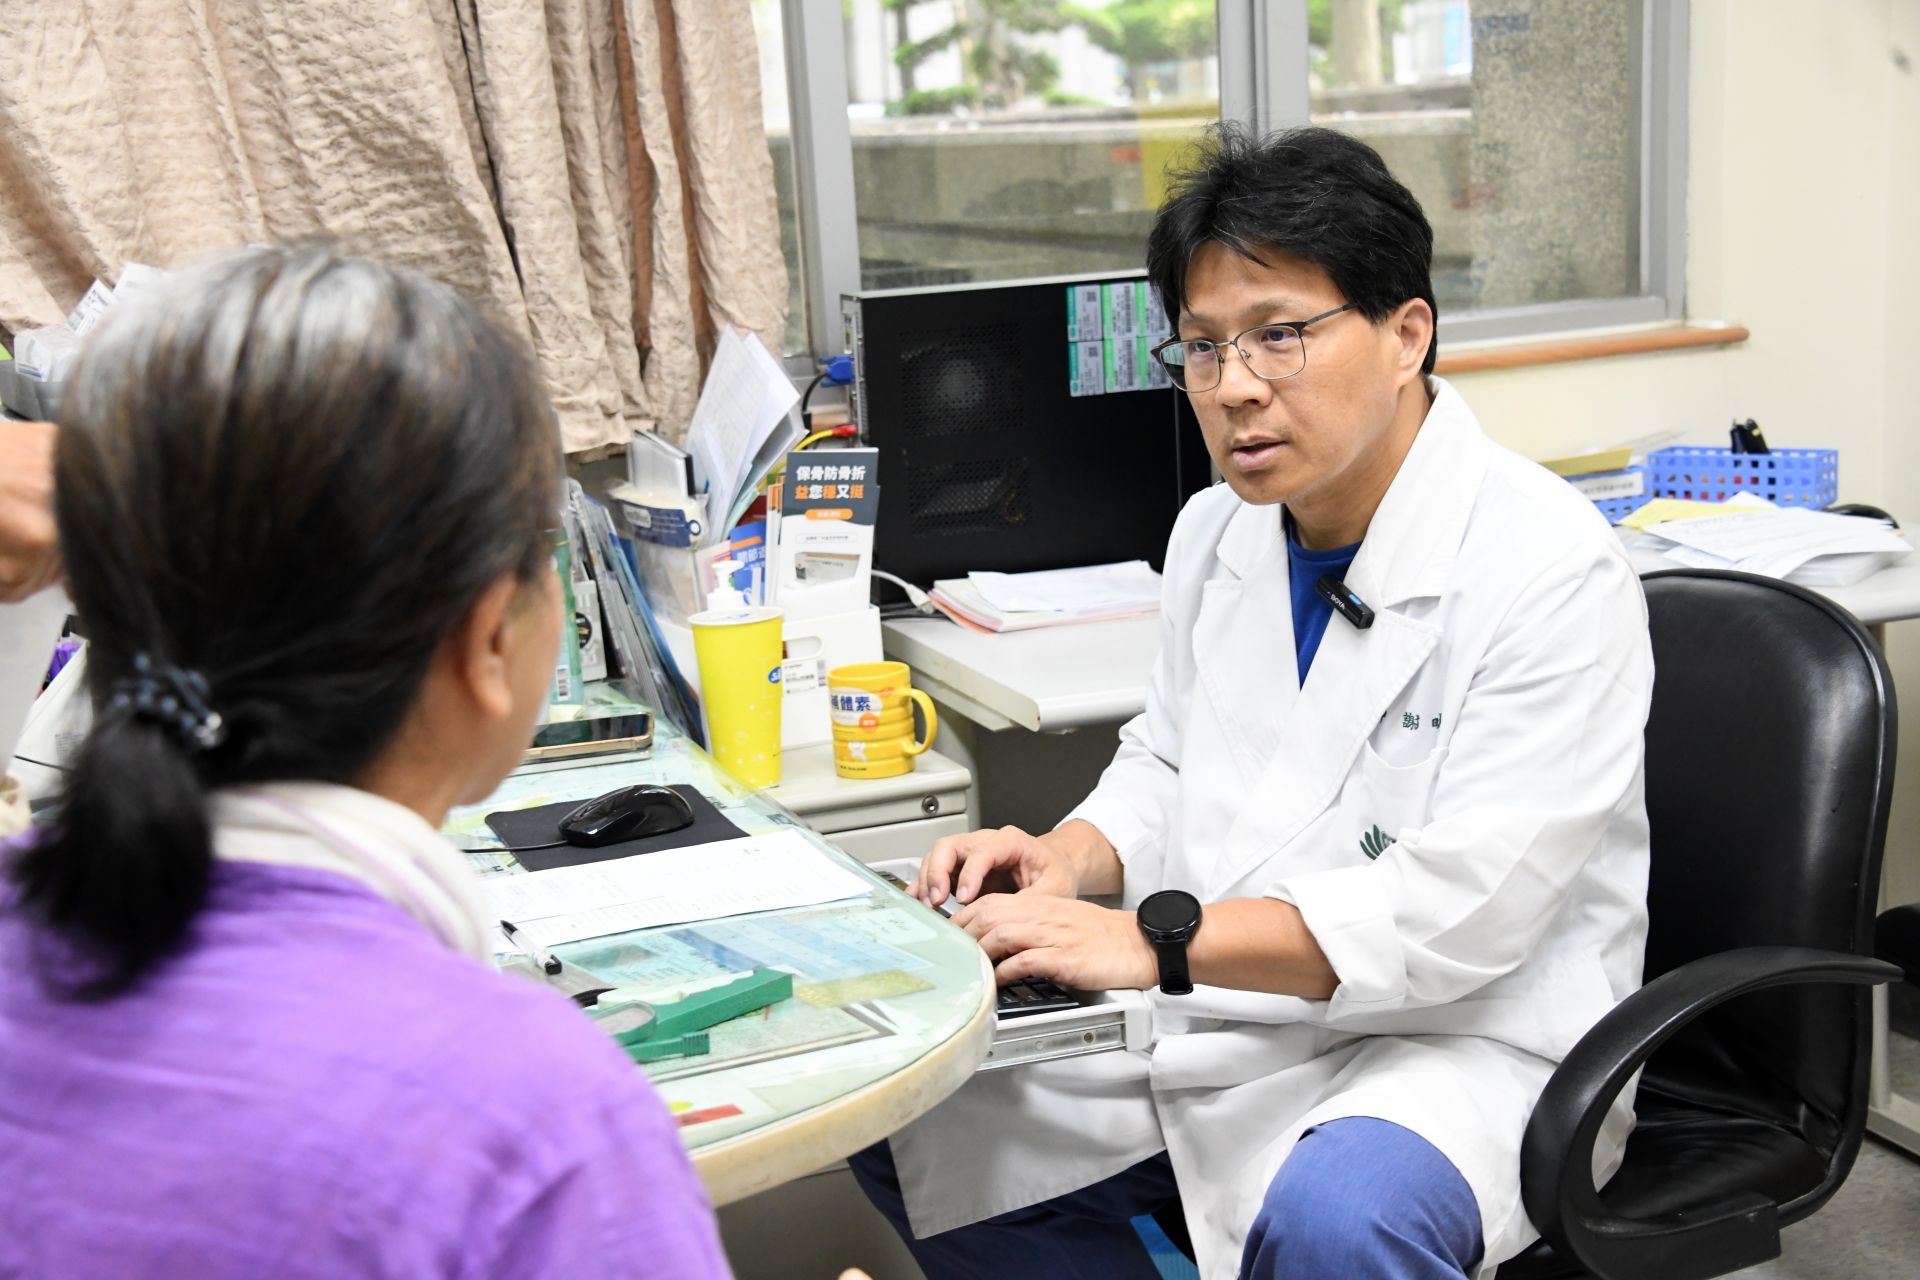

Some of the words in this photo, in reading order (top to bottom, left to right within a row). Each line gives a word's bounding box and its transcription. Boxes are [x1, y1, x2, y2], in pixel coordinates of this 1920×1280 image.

[796, 465, 866, 481] 保骨防骨折
